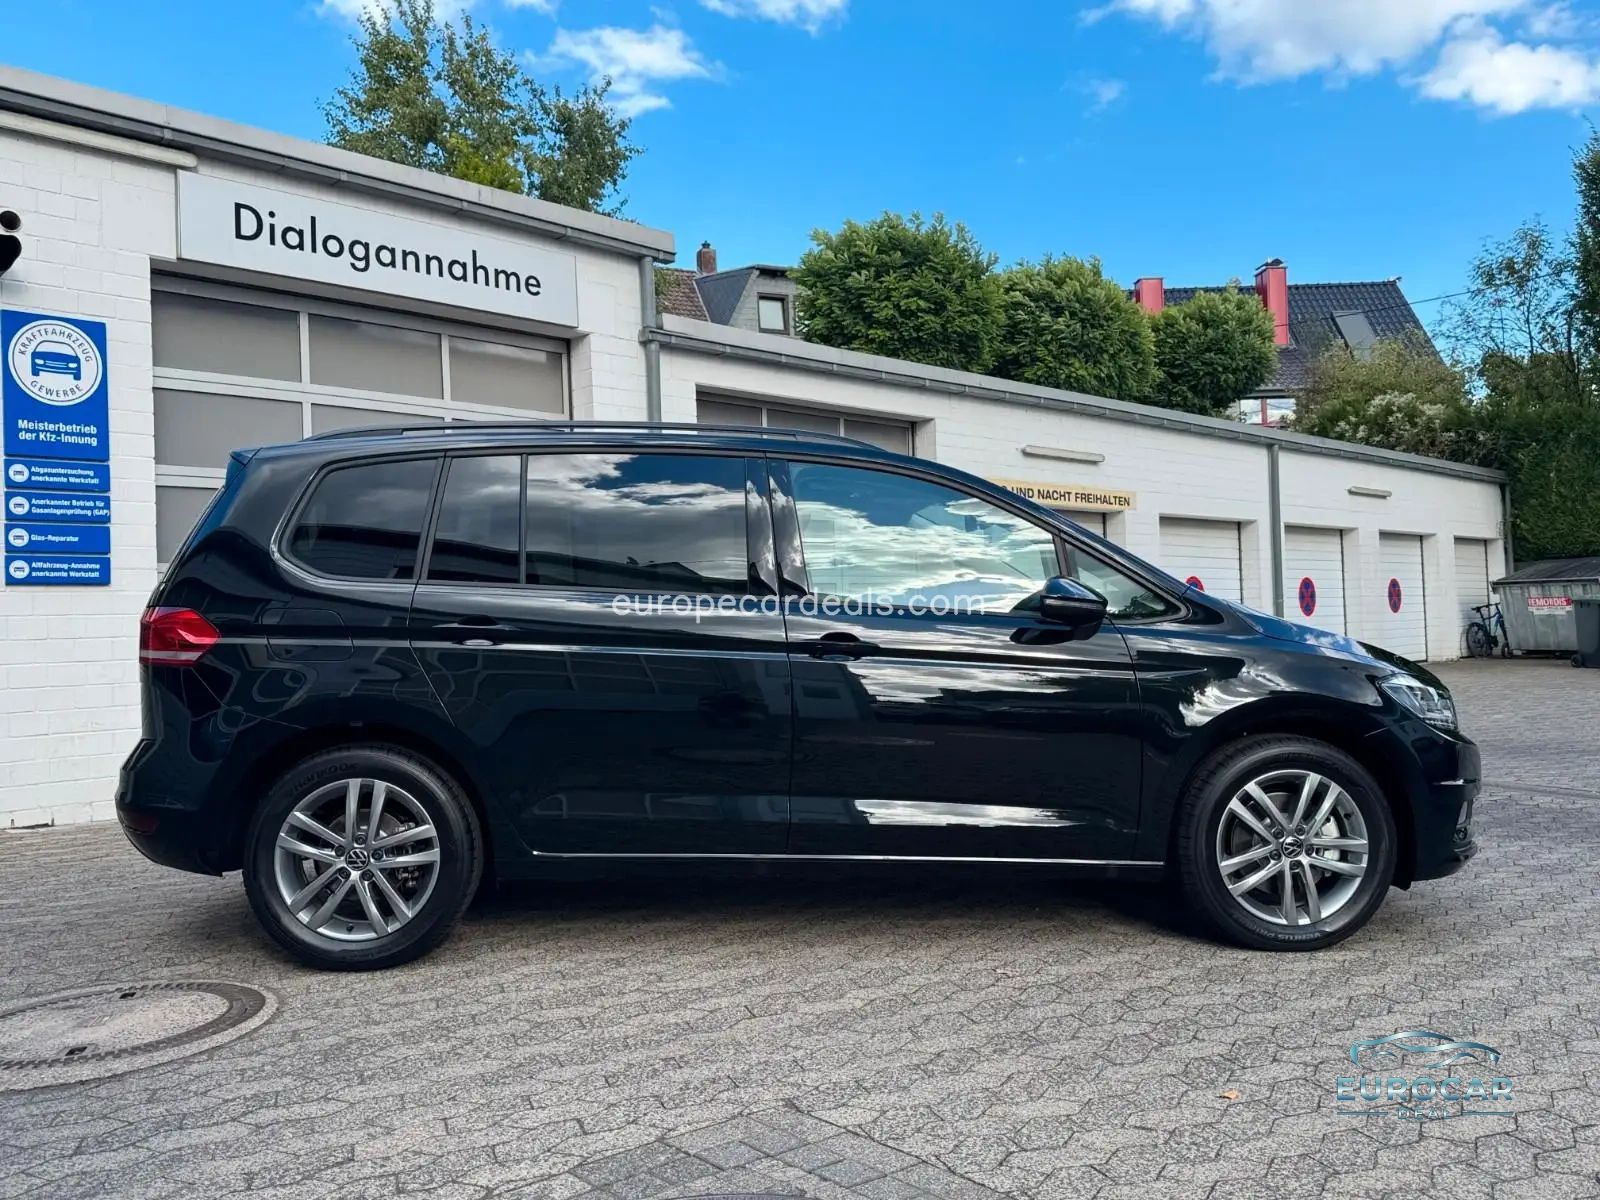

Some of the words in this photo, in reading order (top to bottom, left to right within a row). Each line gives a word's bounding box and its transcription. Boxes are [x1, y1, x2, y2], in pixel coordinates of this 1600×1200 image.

[233, 201, 543, 297] Dialogannahme
[18, 328, 92, 362] KRAFTFAHRZEUG
[30, 380, 83, 397] GEWERBE
[18, 419, 97, 434] Meisterbetrieb
[18, 430, 37, 441] der
[39, 431, 98, 447] Kfz-Innung
[1037, 488, 1072, 503] NACHT
[1074, 492, 1130, 507] FREIHALTEN
